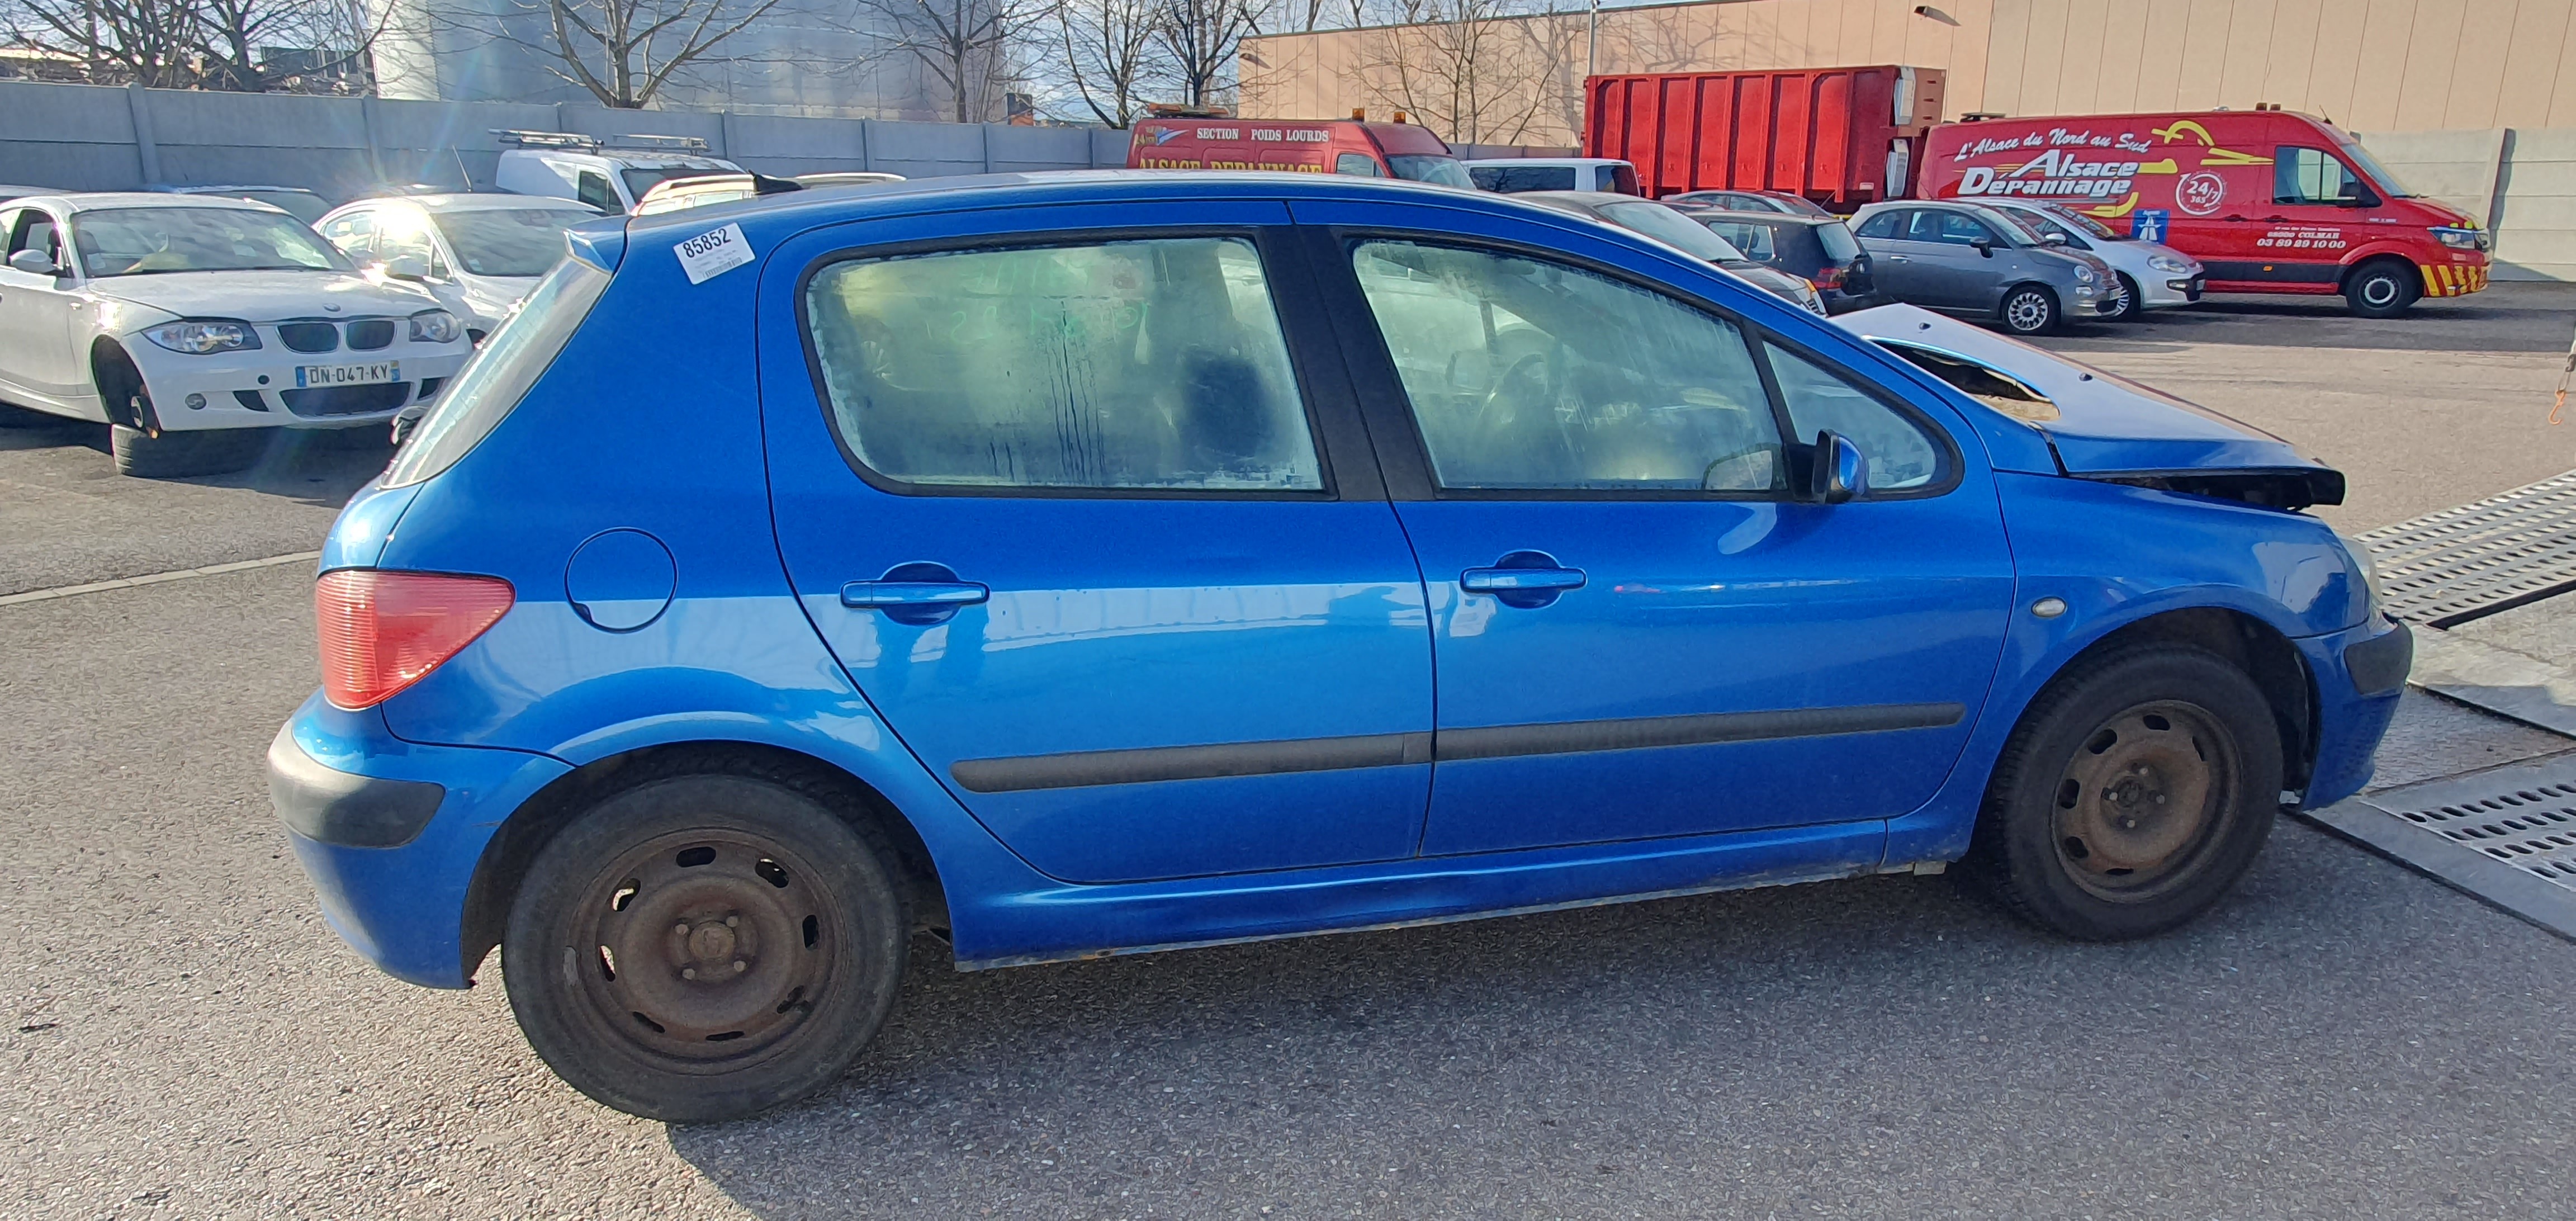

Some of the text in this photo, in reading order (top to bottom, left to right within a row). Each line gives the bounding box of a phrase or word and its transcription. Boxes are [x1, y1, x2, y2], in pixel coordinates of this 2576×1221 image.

[1197, 127, 1329, 142] SECTION POIDS LOURDS
[1954, 128, 2152, 162] L'Alsace du Nord au Sud
[2009, 149, 2140, 178] Alsace
[2186, 180, 2219, 200] 24/7
[683, 228, 732, 258] 85852
[2312, 240, 2327, 249] 10
[2328, 240, 2347, 249] 00
[309, 365, 387, 384] DN-047-KY
